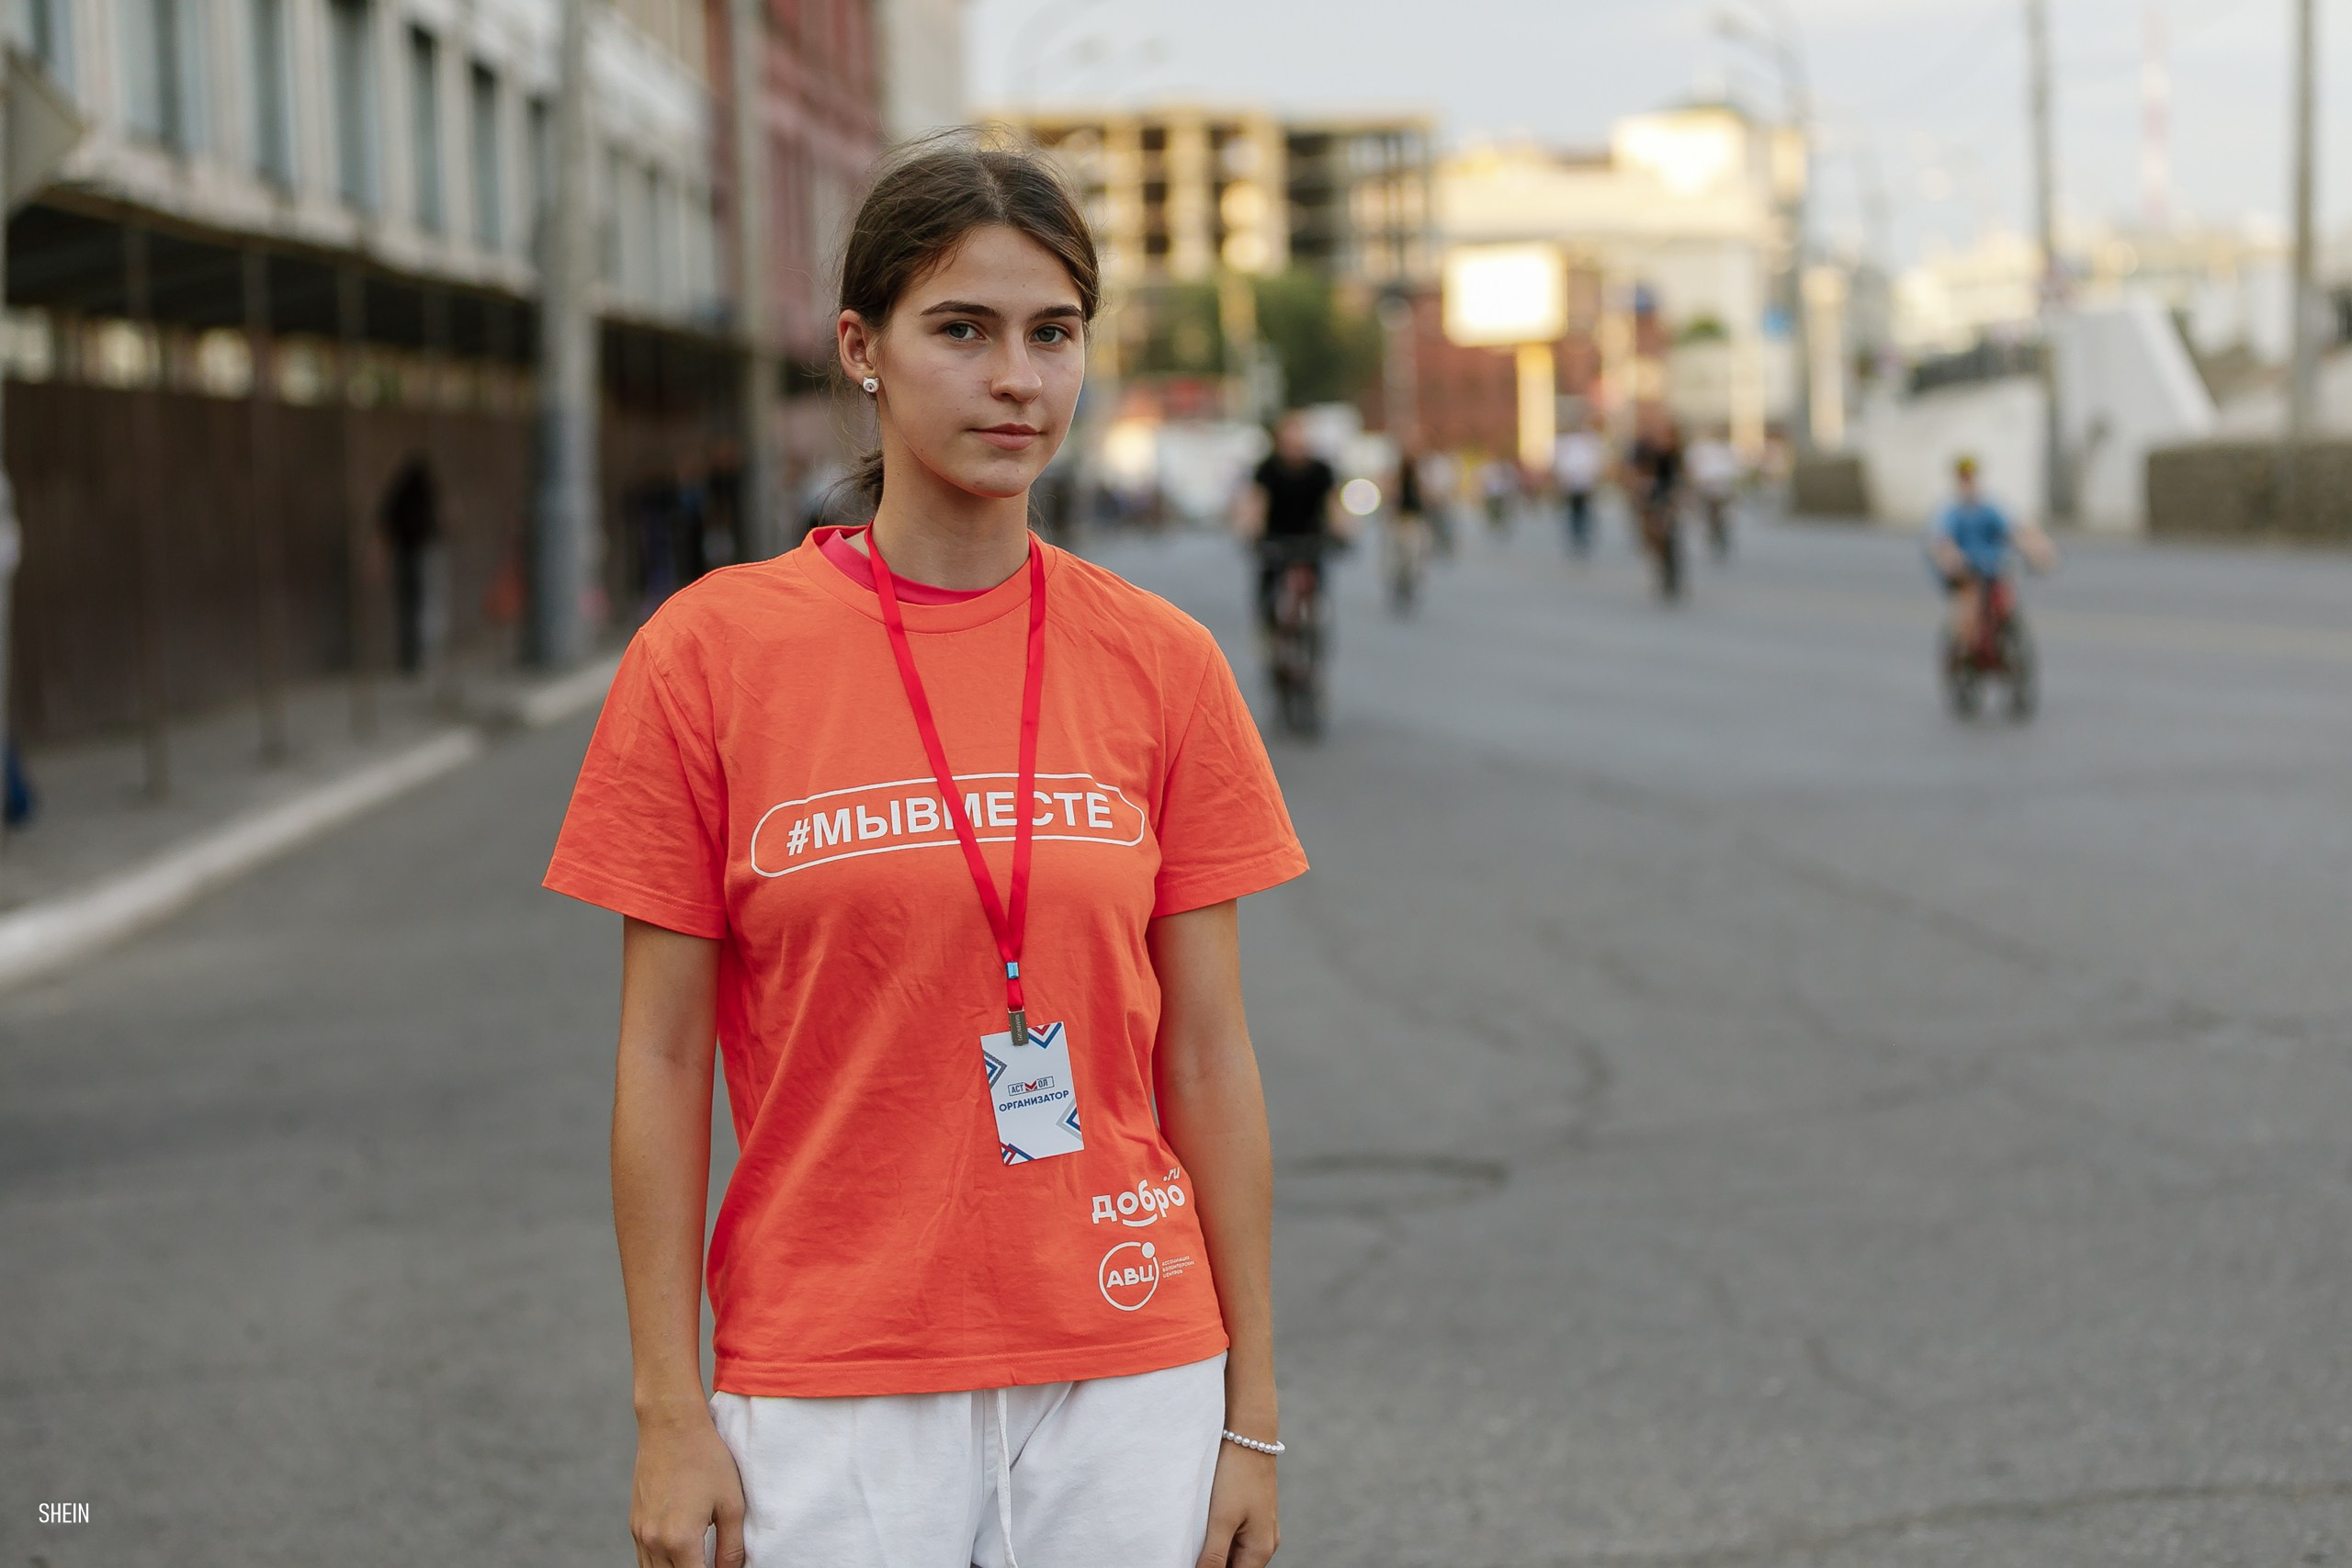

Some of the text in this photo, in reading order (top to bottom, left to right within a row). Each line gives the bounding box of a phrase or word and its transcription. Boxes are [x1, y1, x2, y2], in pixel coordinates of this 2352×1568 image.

[786, 791, 1114, 856] #МЫВМЕСТЕ
[999, 1089, 1069, 1111] ОРГАНИЗАТОР
[1106, 1264, 1155, 1288] АВЦ
